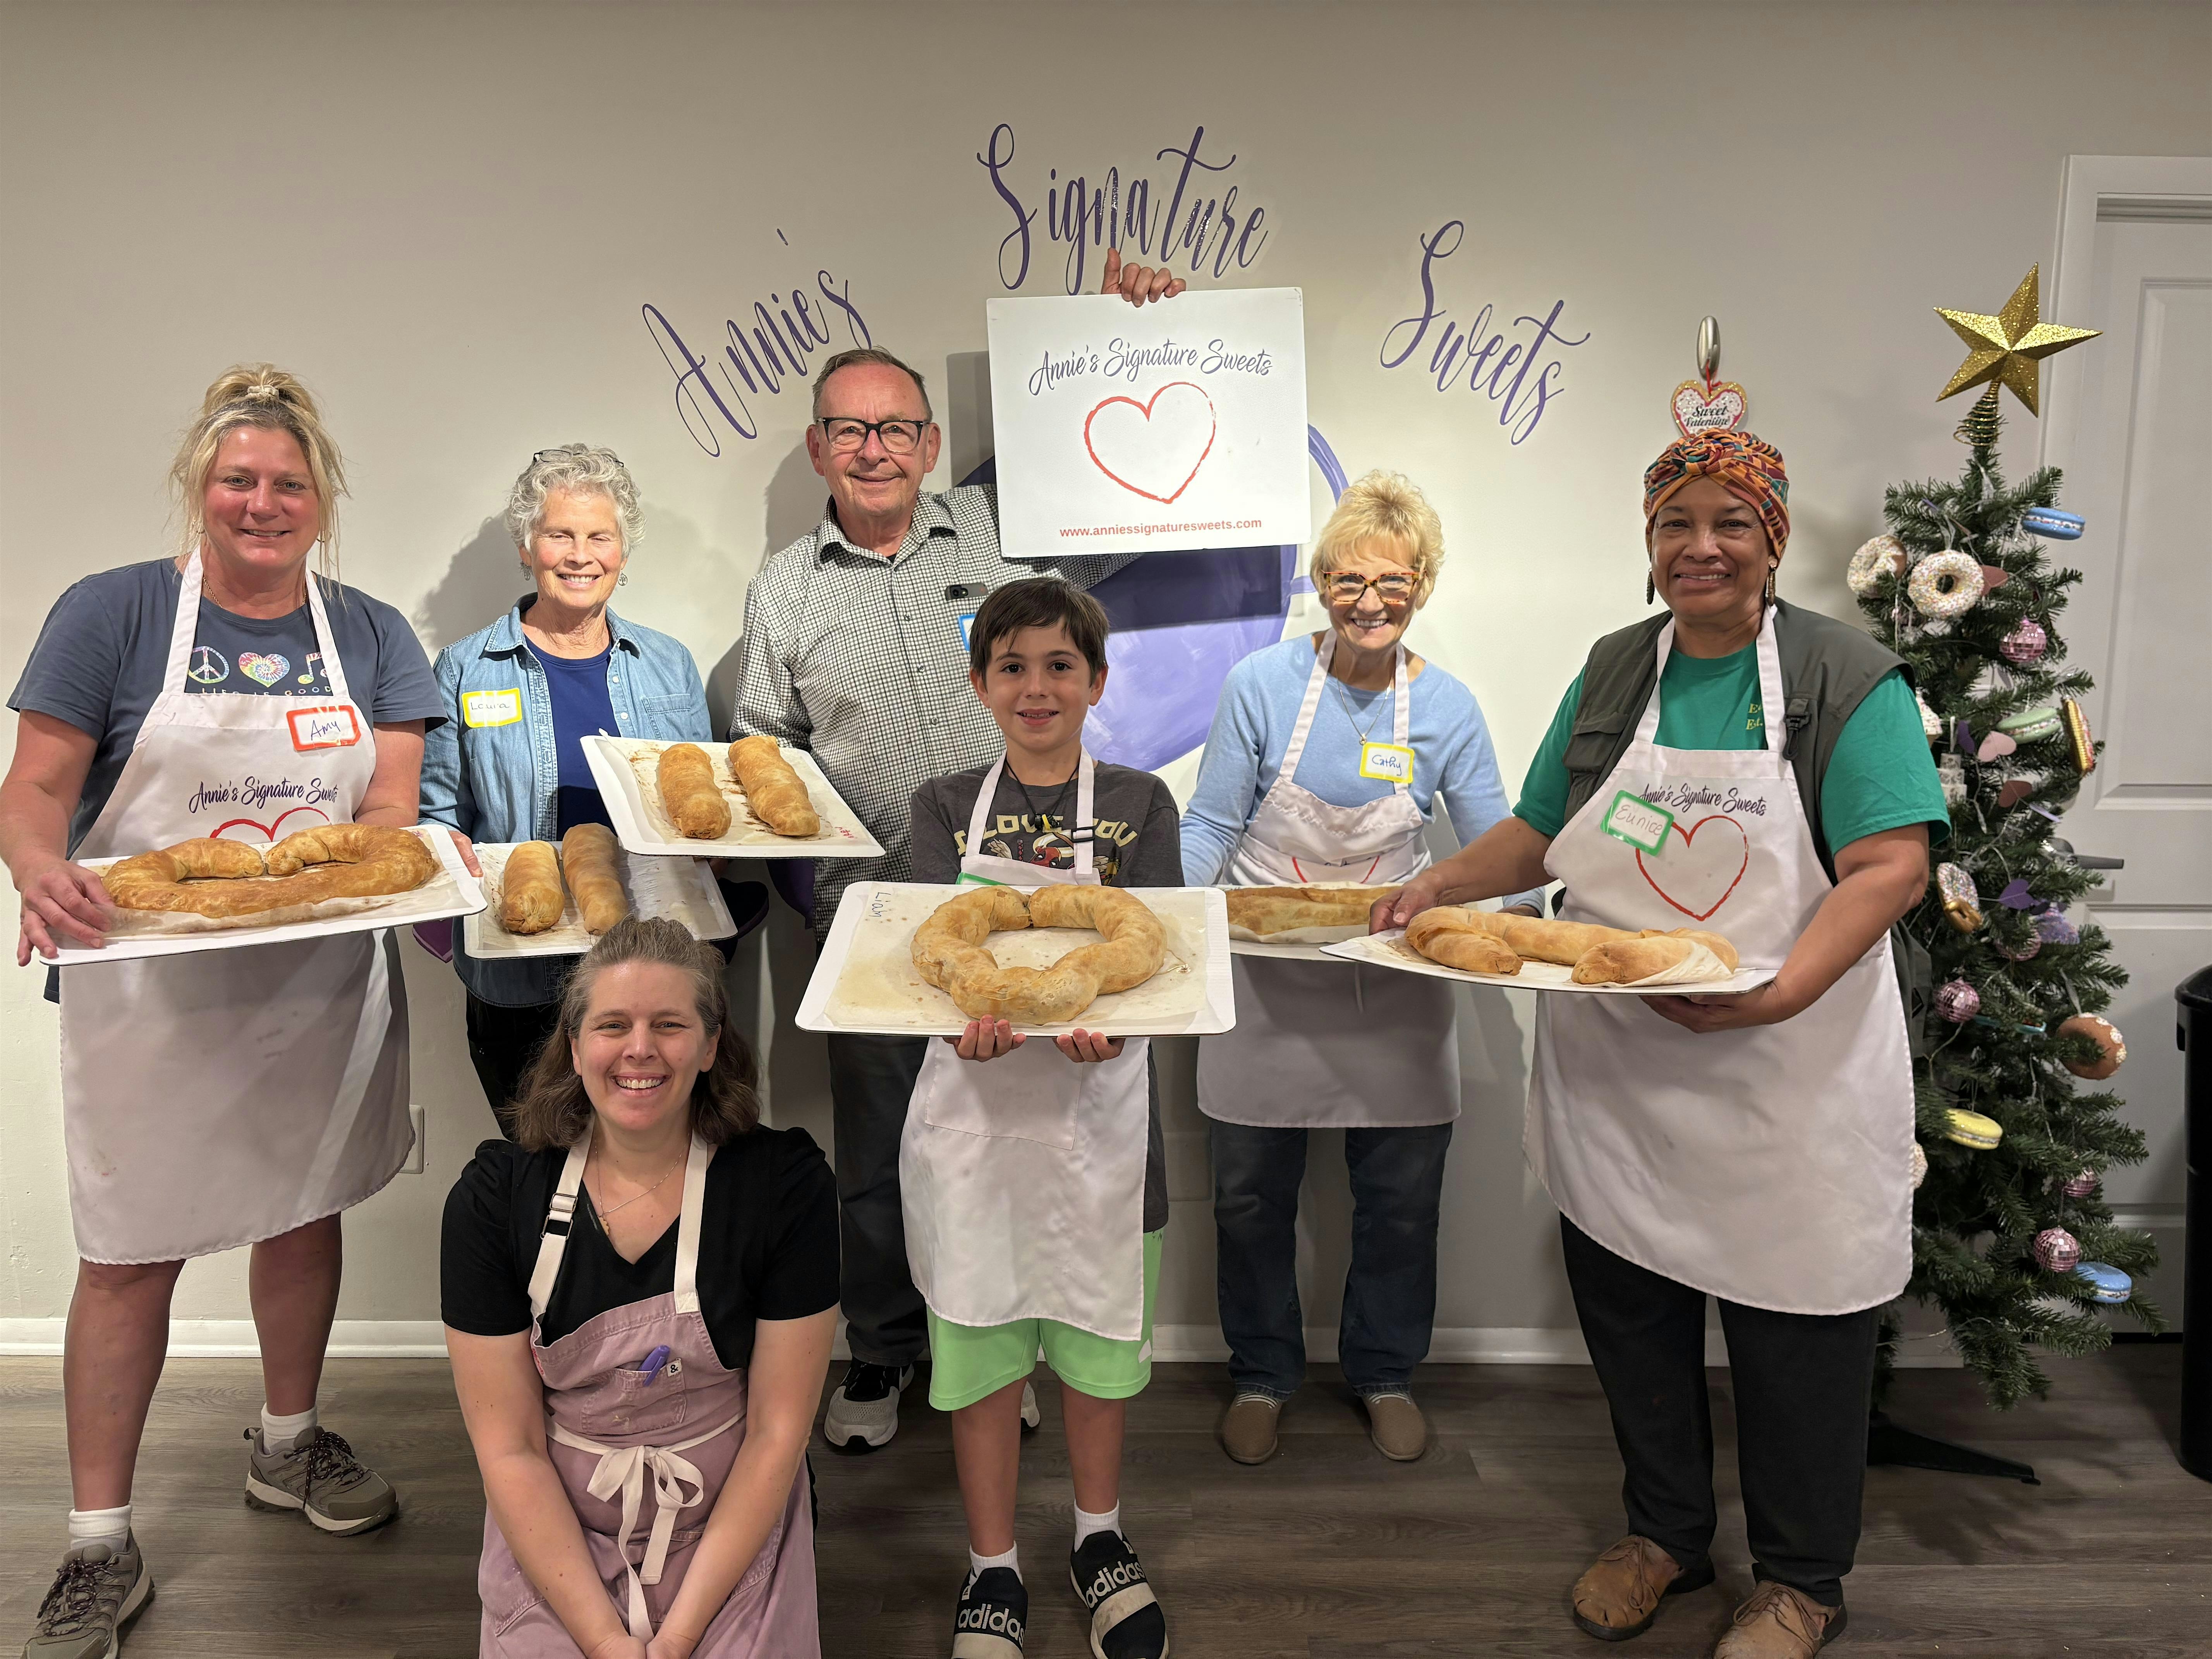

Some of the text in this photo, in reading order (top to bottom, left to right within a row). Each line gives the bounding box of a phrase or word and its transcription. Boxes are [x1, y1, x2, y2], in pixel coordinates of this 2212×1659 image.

[642, 123, 1591, 458] Annie's Signature Sweets
[1029, 338, 1273, 395] Annie's Signature Sweets
[1684, 417, 1730, 426] Valentine
[1692, 405, 1728, 417] Sweet
[1060, 520, 1262, 537] www.anniessignaturesweets.com
[284, 686, 331, 696] GOOD
[311, 720, 341, 740] Amy
[1372, 754, 1402, 776] Cathy
[189, 780, 240, 813] Annie's
[241, 776, 305, 809] Signature
[1638, 783, 1767, 816] Annie's Signature Sweets
[1093, 818, 1138, 847] OU
[1615, 804, 1663, 836] Eunice
[1086, 1561, 1146, 1608] adidas
[958, 1603, 1025, 1648] adidas
